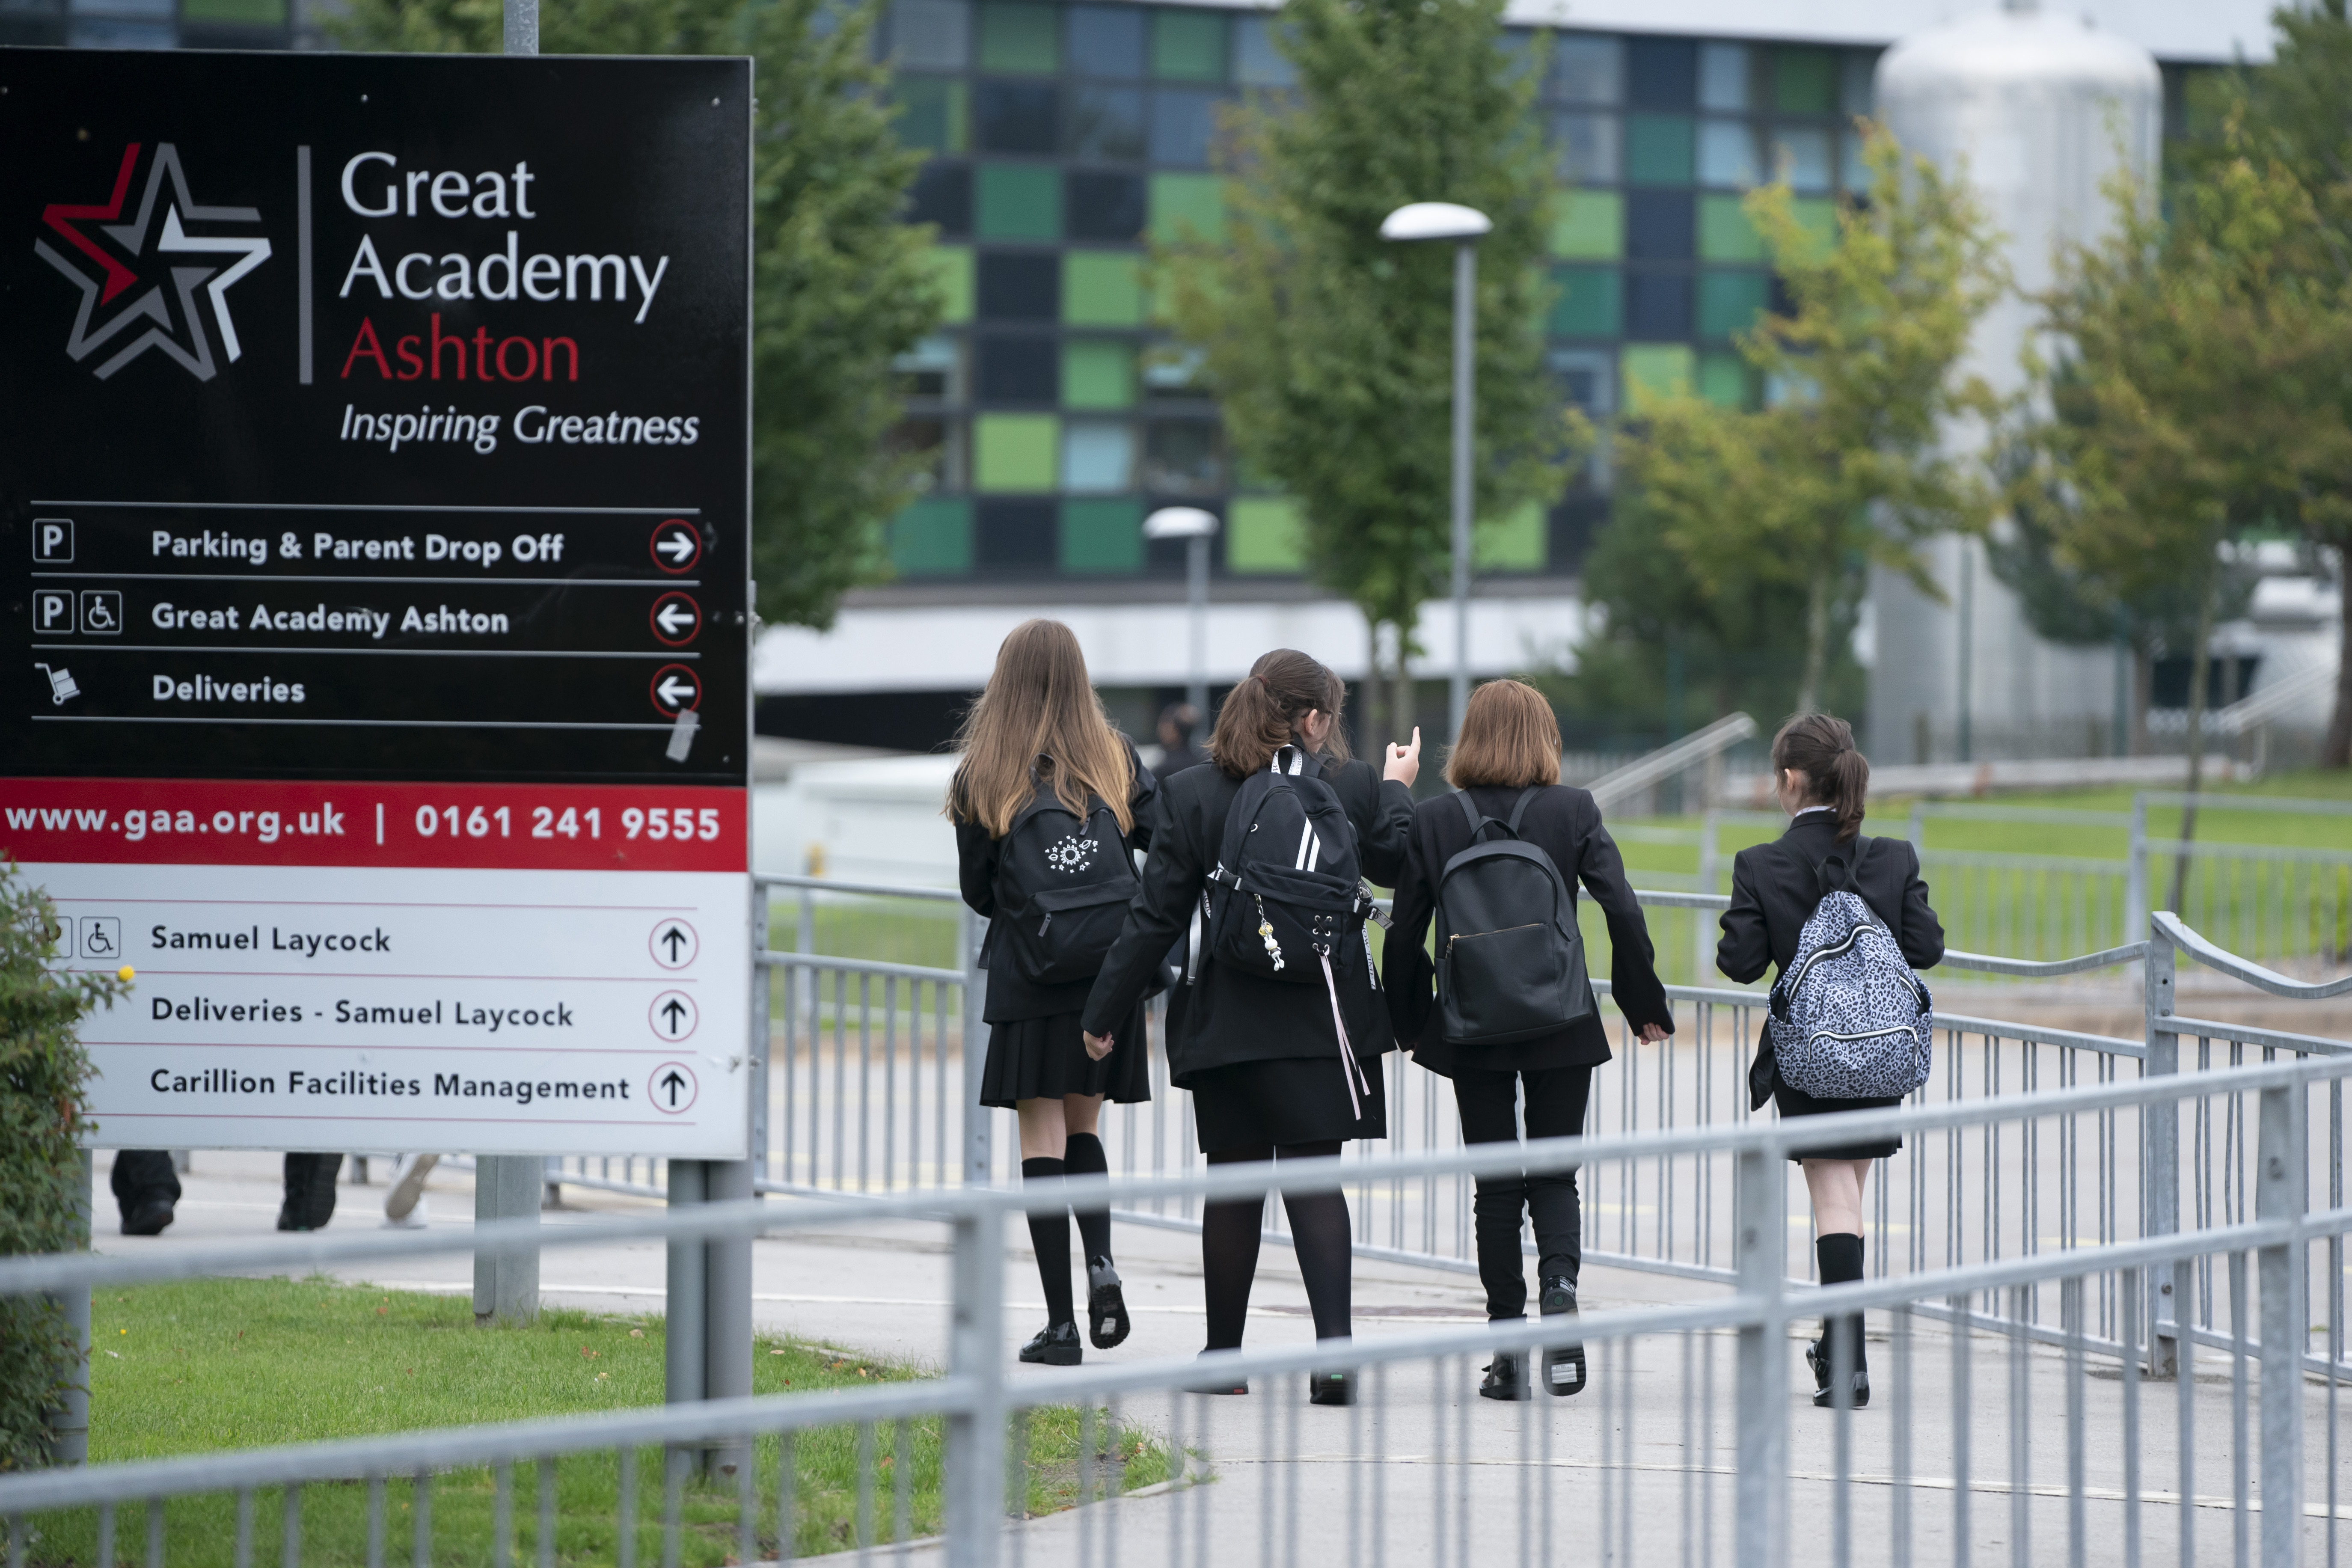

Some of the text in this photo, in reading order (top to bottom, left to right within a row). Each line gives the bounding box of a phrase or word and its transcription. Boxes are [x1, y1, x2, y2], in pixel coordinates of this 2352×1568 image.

[342, 151, 535, 218] Great
[339, 231, 668, 323] Academy
[341, 312, 578, 381] Ashton
[341, 404, 699, 453] Inspiring Greatness
[44, 525, 62, 555] P
[153, 530, 564, 567] Parking & Parent Drop Off
[44, 596, 63, 627] P
[152, 603, 508, 638] Great Academy Ashton
[153, 674, 305, 702] Deliveries
[5, 802, 344, 843] www.gaa.org.uk
[416, 805, 510, 837] 0161
[532, 806, 600, 839] 241
[621, 807, 720, 840] 9555
[152, 925, 389, 957] Samuel Laycock
[152, 996, 302, 1022] Deliveries
[336, 1000, 440, 1024] Samuel
[457, 1003, 571, 1032] Laycock
[151, 1069, 628, 1104] Carillion Facilities Management
